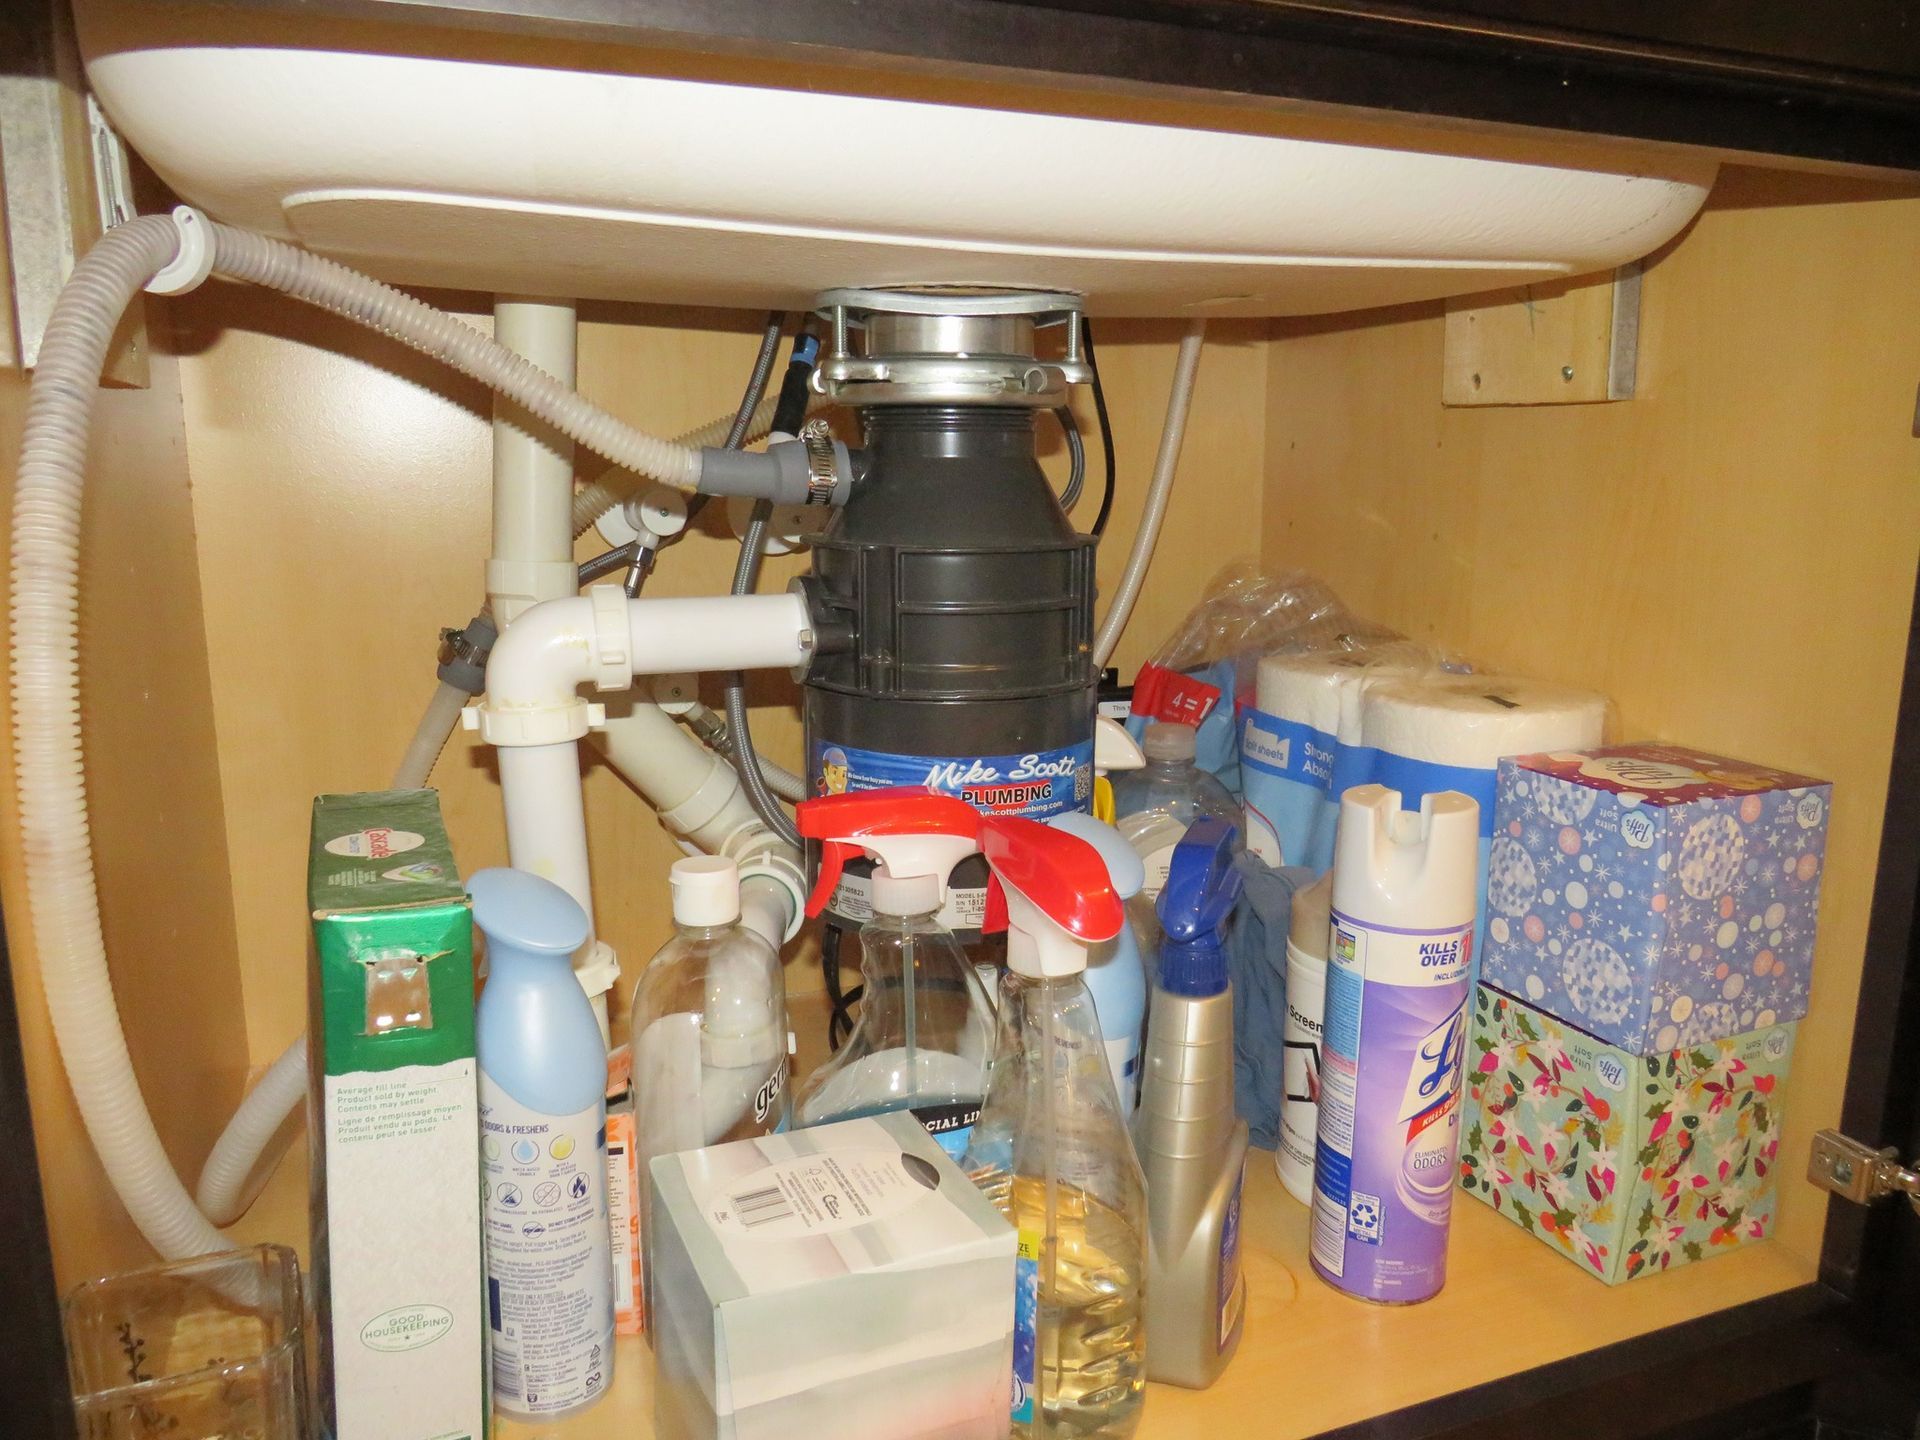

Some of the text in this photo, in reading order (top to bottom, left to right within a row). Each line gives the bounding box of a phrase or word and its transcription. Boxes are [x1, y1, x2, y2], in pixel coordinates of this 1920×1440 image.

[922, 754, 1076, 789] Mike Scott
[961, 784, 1052, 806] PLUMBING
[978, 800, 1063, 817] kescottplumbing.com
[1600, 808, 1618, 821] Soft
[1595, 818, 1617, 833] Ultra
[1626, 818, 1650, 843] Puffs
[1419, 940, 1458, 955] KILLS
[1421, 953, 1456, 967] OVER
[1290, 1004, 1324, 1034] Screen
[1574, 1045, 1592, 1060] Soft
[1570, 1054, 1591, 1071] Ultra
[1600, 1060, 1622, 1086] Puffs
[337, 1087, 373, 1096] Average
[337, 1095, 372, 1103] Product
[375, 1092, 393, 1100] sold
[395, 1091, 405, 1099] by
[337, 1104, 377, 1113] Contents
[338, 1117, 362, 1127] Ligne
[378, 1109, 431, 1122] remplissage
[434, 1104, 462, 1114] moyen
[922, 1116, 958, 1131] CIAL
[1422, 1109, 1442, 1127] KILLS
[338, 1125, 371, 1134] Produit
[374, 1121, 399, 1130] vendu
[402, 1119, 412, 1127] au
[506, 1125, 511, 1134] &
[512, 1123, 549, 1134] FRESHENS
[338, 1134, 374, 1143] contenu
[376, 1130, 396, 1140] peut
[1413, 1154, 1448, 1170] ODORS
[365, 1316, 450, 1339] HOUSEKEEPING
[389, 1313, 424, 1327] GOOD
